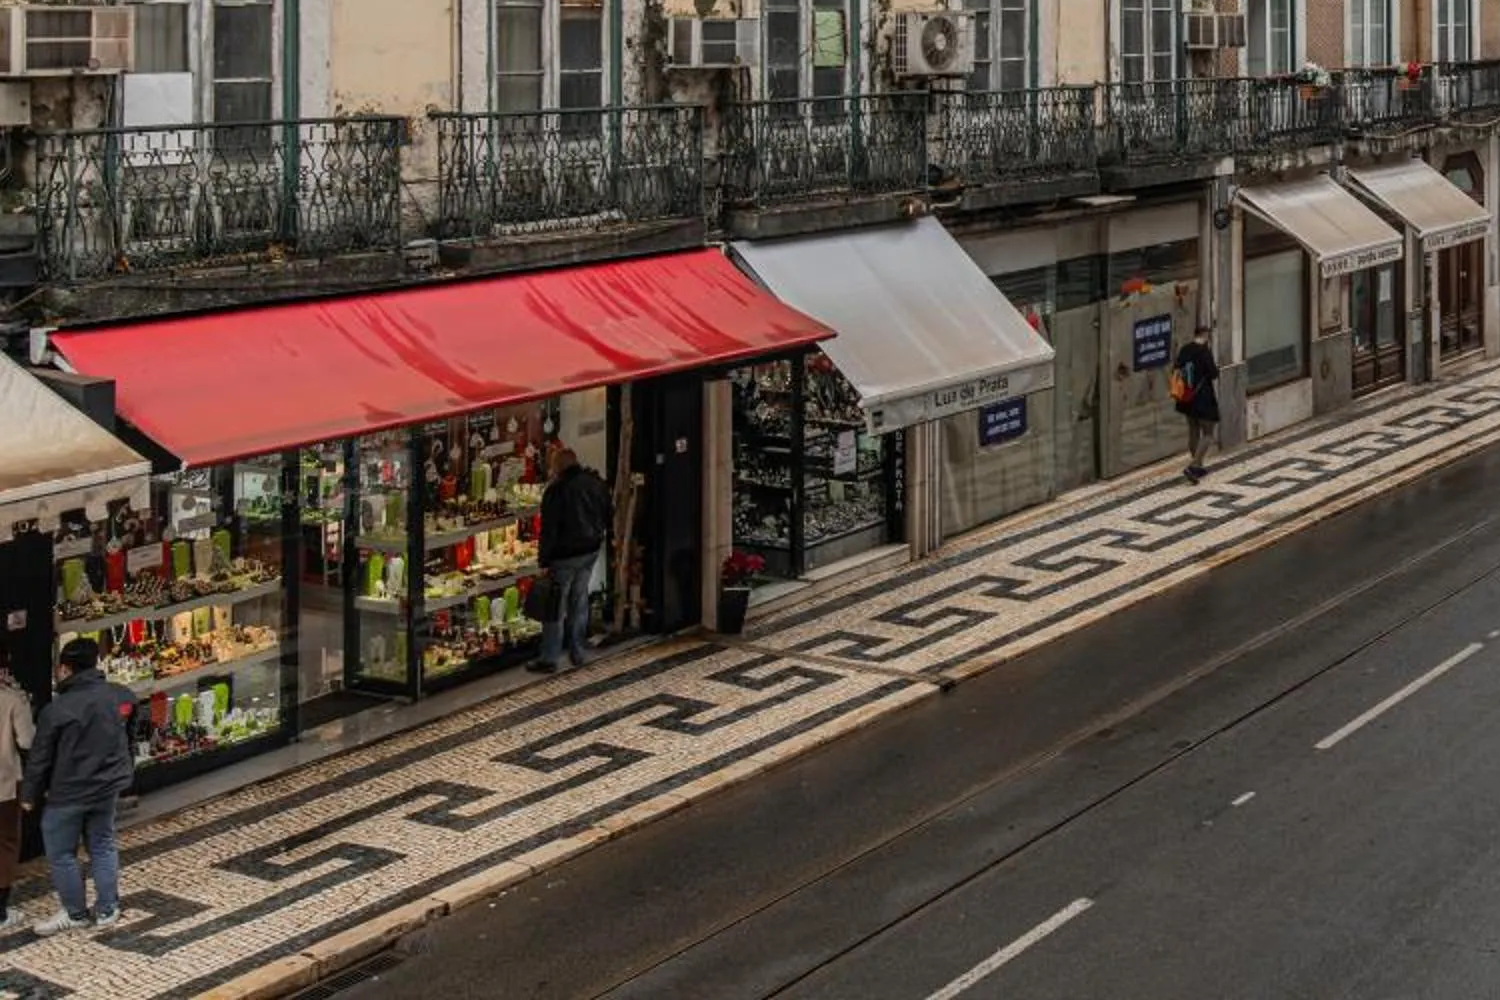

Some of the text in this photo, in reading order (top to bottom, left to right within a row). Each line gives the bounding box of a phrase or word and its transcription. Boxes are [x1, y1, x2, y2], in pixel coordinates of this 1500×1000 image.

[960, 383, 974, 400] de
[980, 376, 1009, 393] Prata
[895, 457, 904, 512] PRATA
